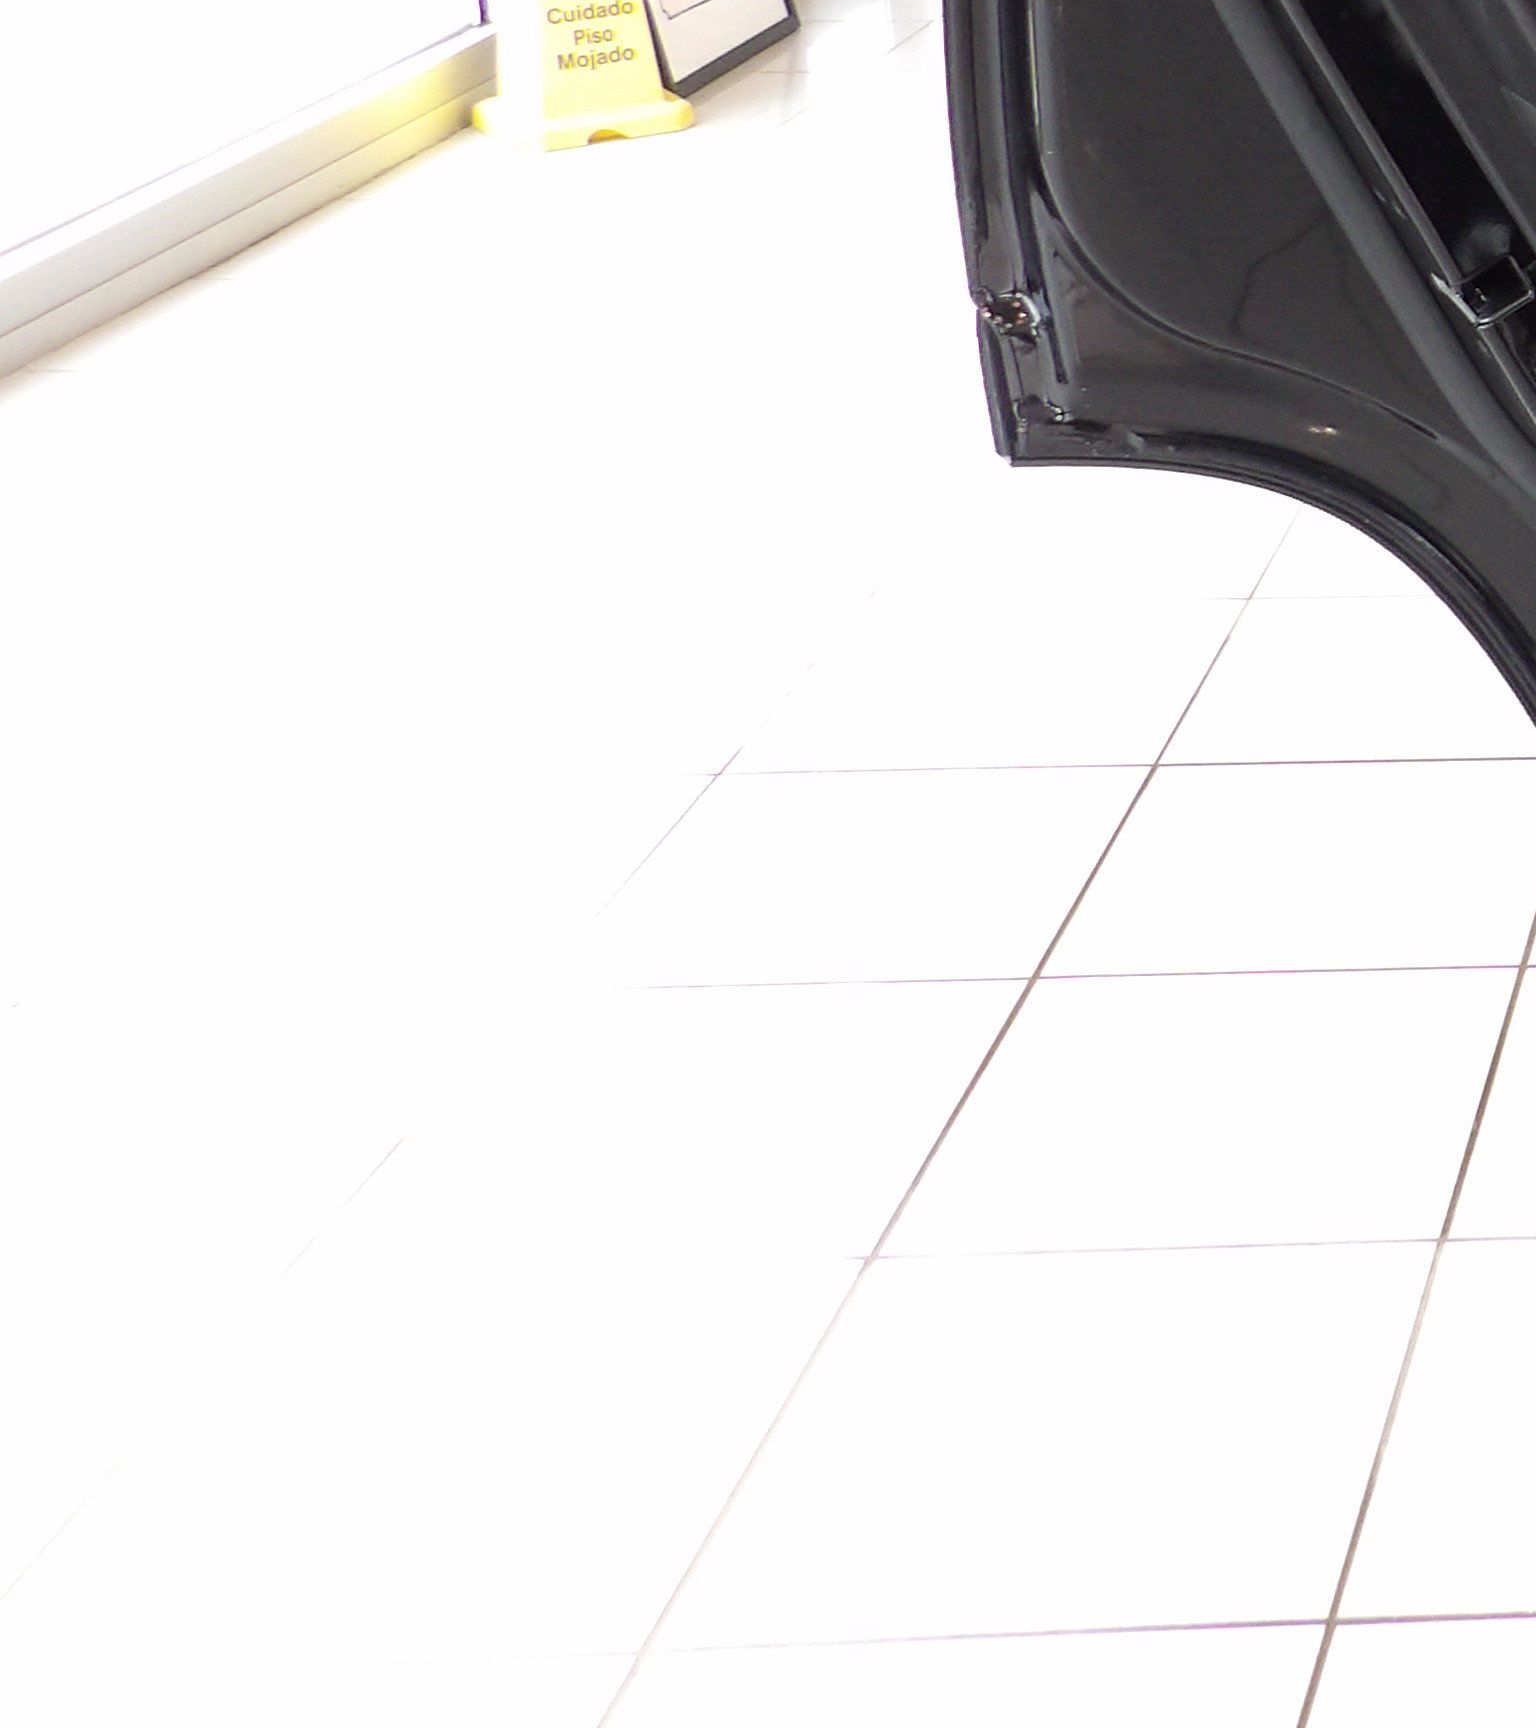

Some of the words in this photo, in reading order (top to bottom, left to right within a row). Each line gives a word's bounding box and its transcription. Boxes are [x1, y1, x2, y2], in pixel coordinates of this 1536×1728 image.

[546, 0, 634, 25] Cuidado
[573, 28, 615, 46] Piso
[556, 48, 636, 70] Mojado
